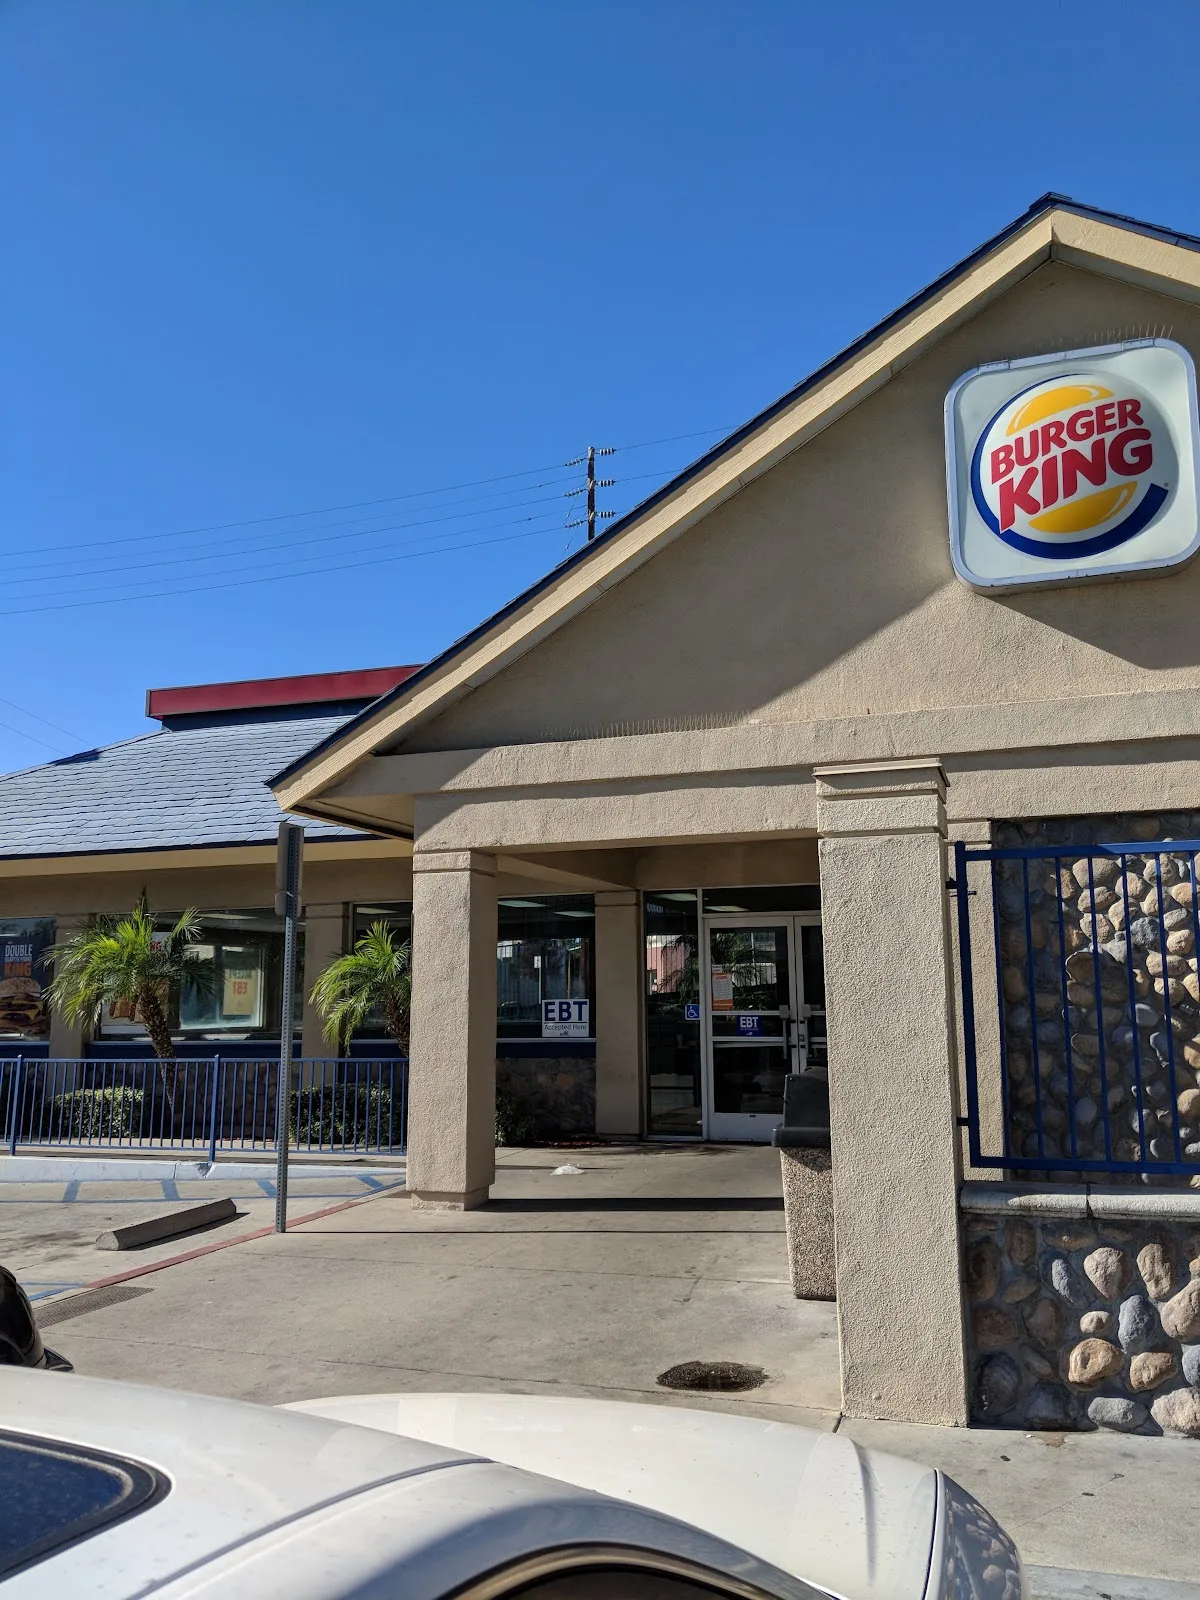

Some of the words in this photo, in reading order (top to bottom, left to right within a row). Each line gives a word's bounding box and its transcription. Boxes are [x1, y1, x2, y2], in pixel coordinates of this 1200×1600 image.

[990, 398, 1144, 485] BURGER
[999, 428, 1153, 532] KING
[5, 944, 33, 957] DOUBLE
[544, 1001, 588, 1022] EBT
[544, 1024, 572, 1032] Accepted
[739, 1016, 759, 1028] EBT
